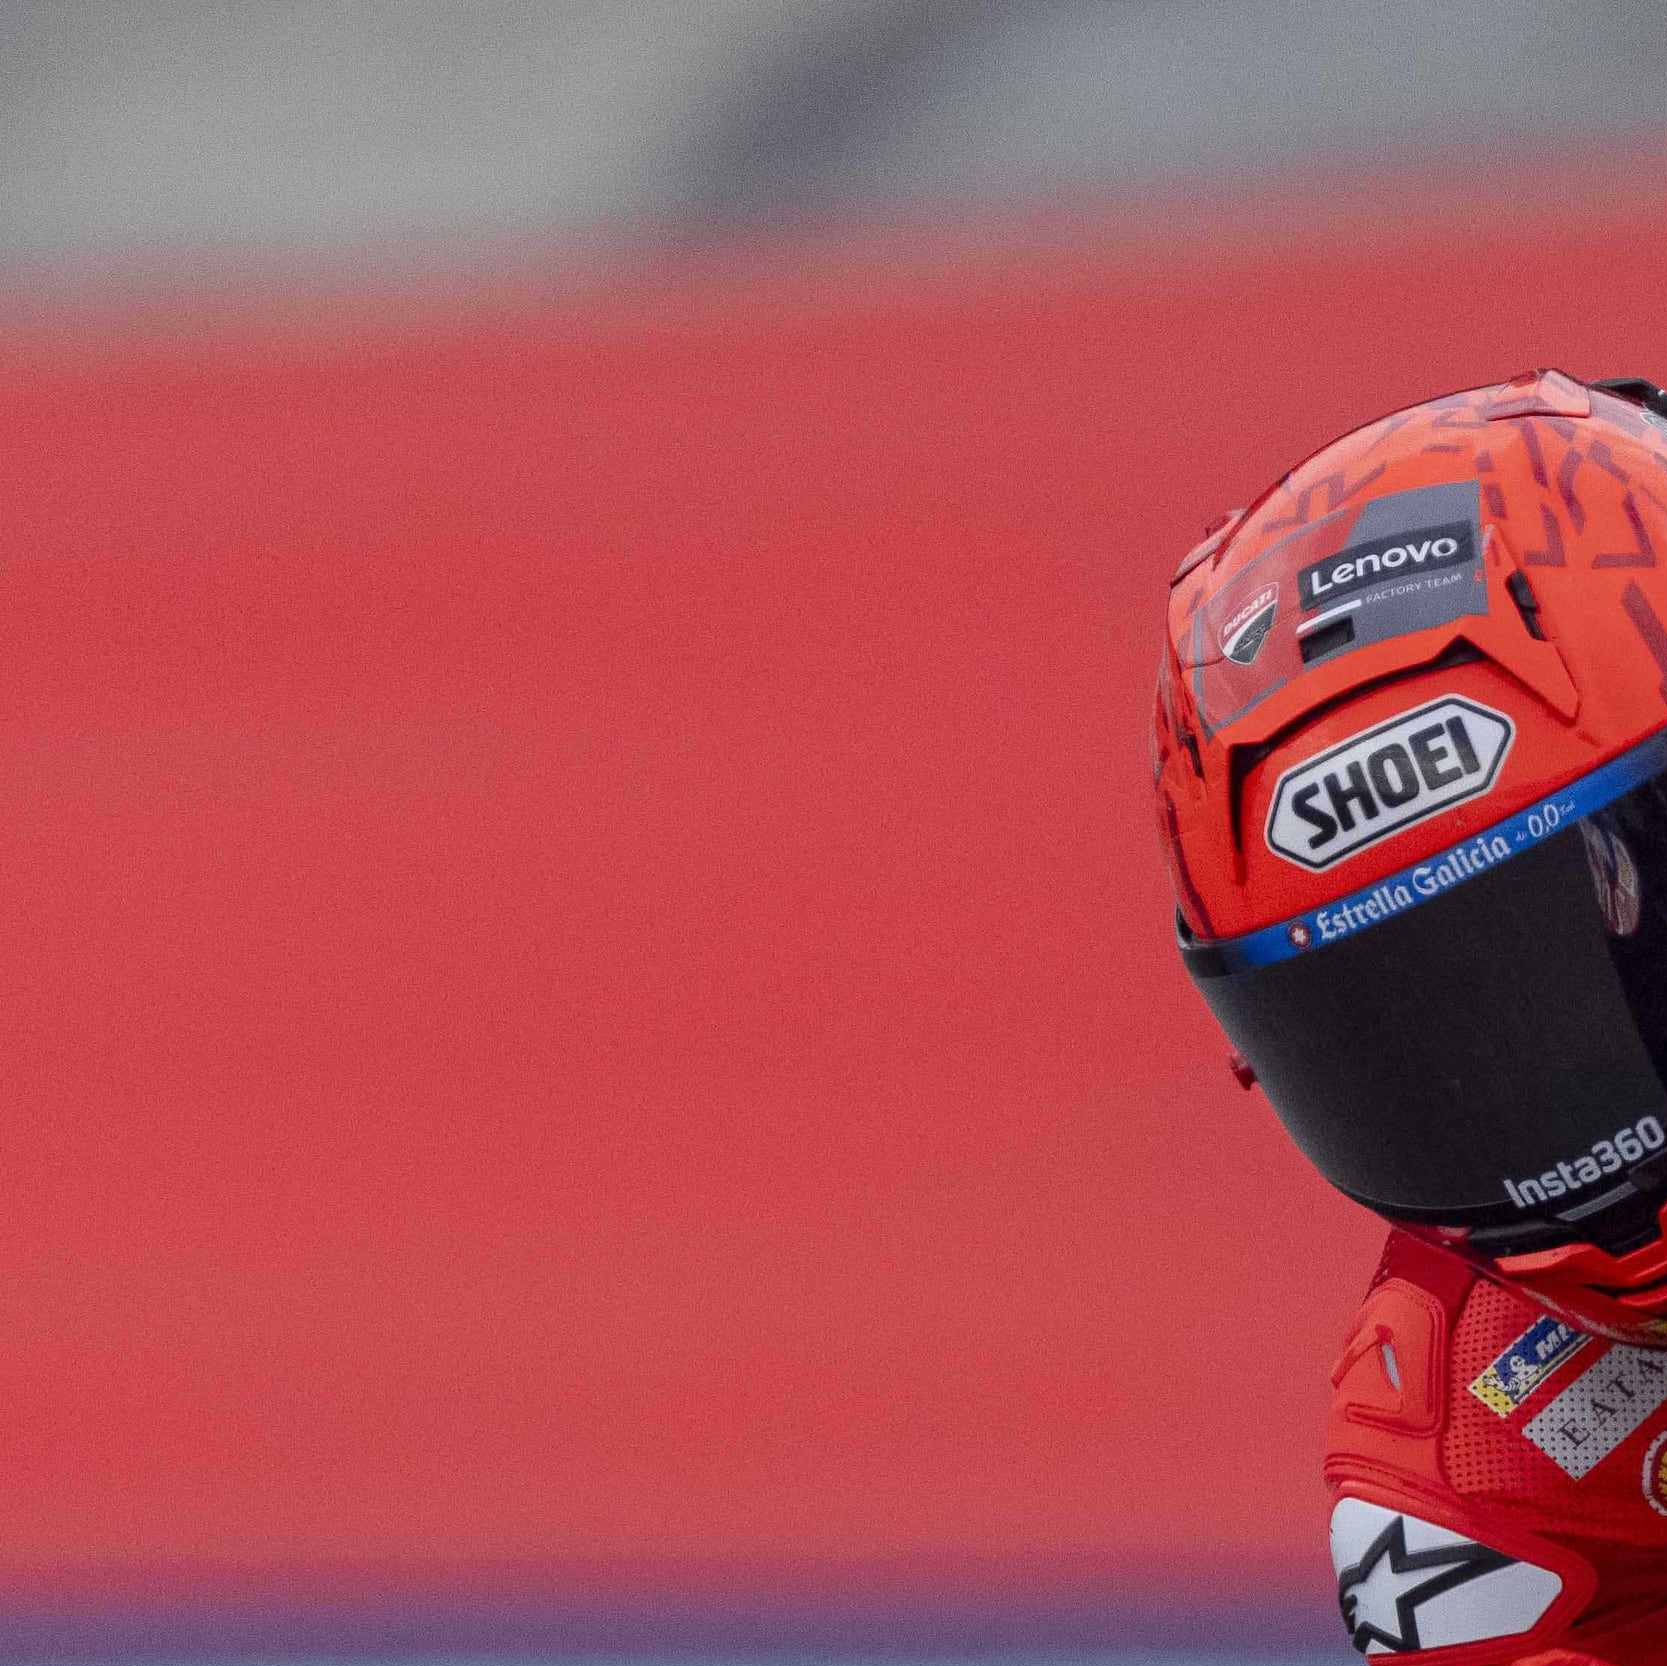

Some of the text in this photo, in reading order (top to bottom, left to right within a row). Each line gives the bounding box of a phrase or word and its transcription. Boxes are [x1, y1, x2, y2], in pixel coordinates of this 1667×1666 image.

[1223, 588, 1273, 636] DUCATI
[1311, 537, 1458, 596] Lenovo
[1366, 572, 1463, 605] FACTORY TEAM
[1291, 717, 1481, 850] SHOEI
[1317, 885, 1415, 940] Estrella
[1411, 835, 1512, 897] Galicia
[1503, 1115, 1667, 1209] Insta360
[1556, 1354, 1664, 1451] EATA
